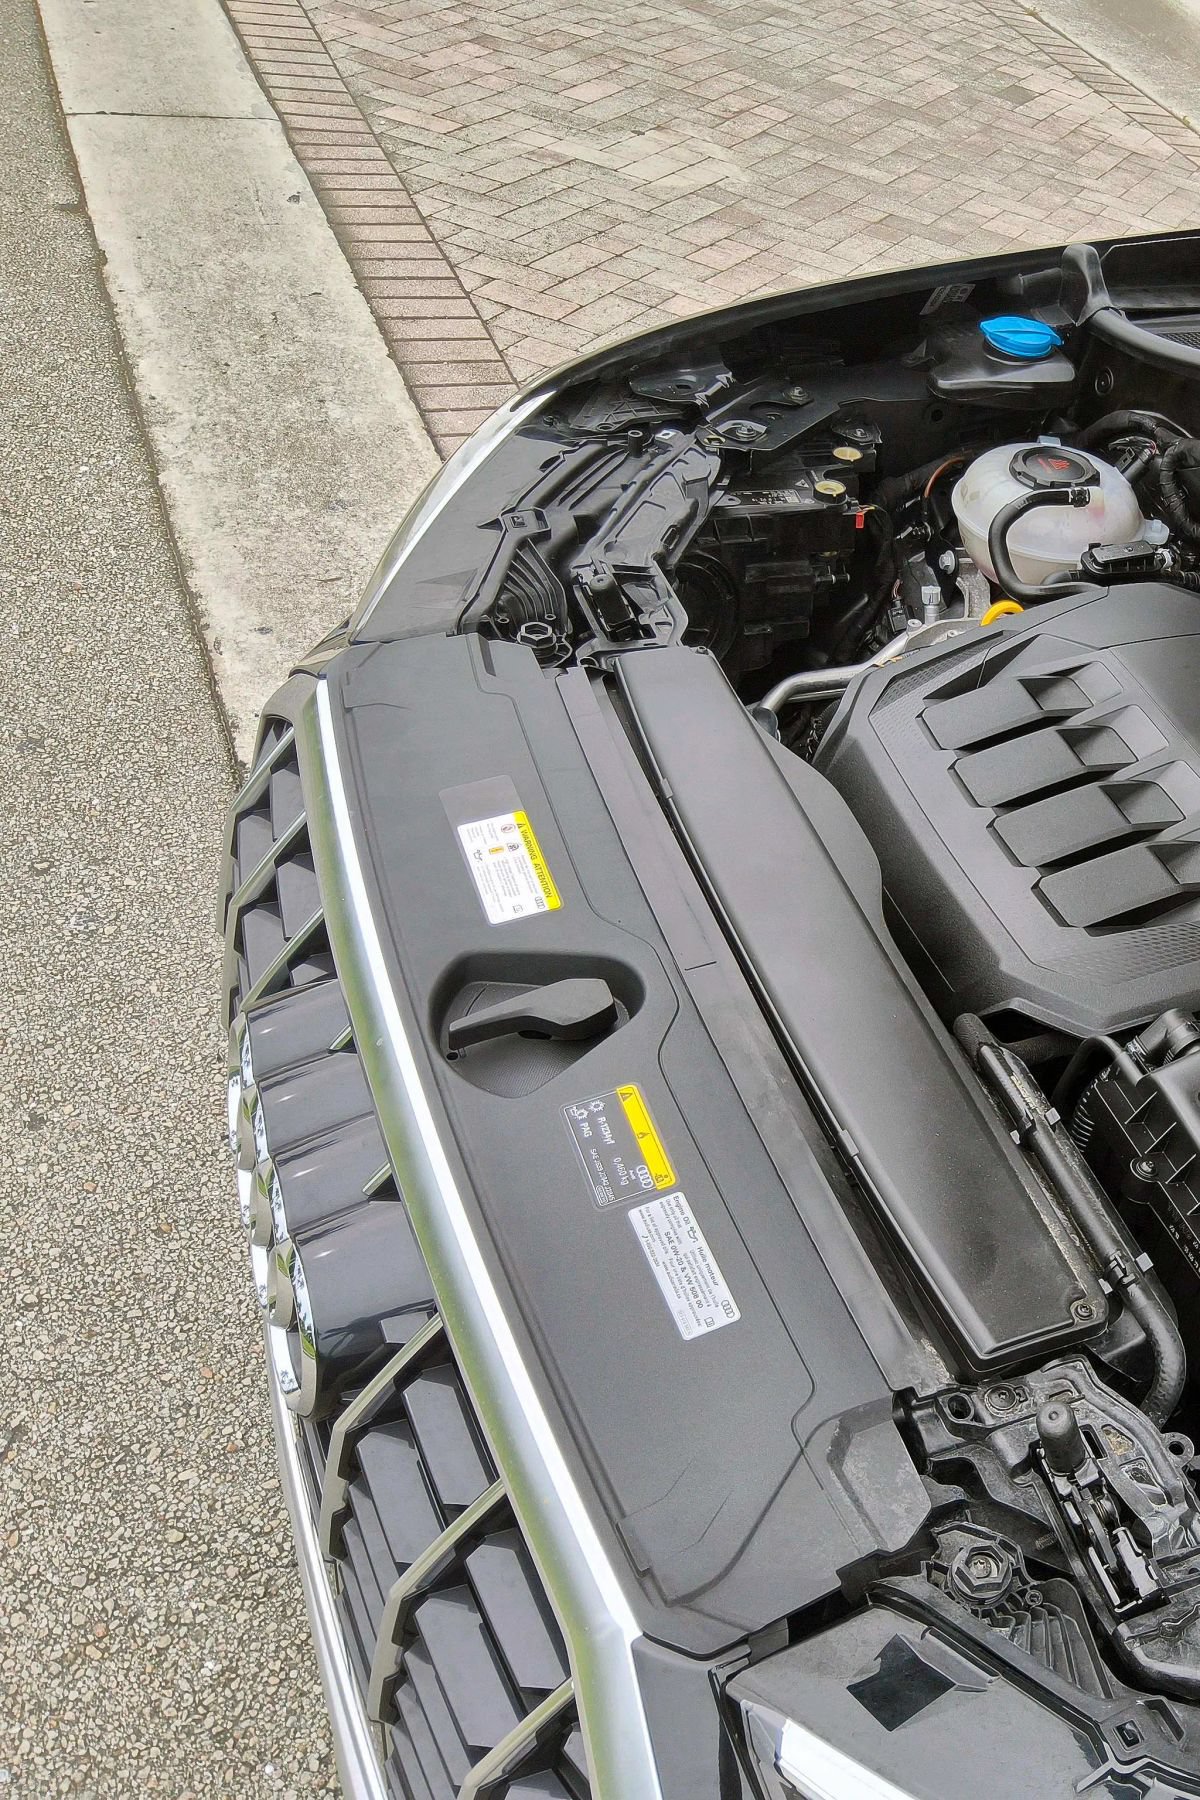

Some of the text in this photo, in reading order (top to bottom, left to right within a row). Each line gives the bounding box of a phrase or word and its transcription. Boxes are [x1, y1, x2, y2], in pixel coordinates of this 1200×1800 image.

[520, 830, 537, 860] WARNING
[533, 863, 552, 897] ATTENTION
[579, 1121, 592, 1137] PAG
[620, 1175, 629, 1185] kg
[672, 1195, 690, 1224] Engine Oil
[663, 1231, 674, 1245] SAE
[670, 1245, 683, 1265] 0W-20
[683, 1273, 693, 1285] VW
[689, 1286, 699, 1299] 508
[695, 1299, 703, 1308] 00
[696, 1246, 718, 1285] Huile moteur
